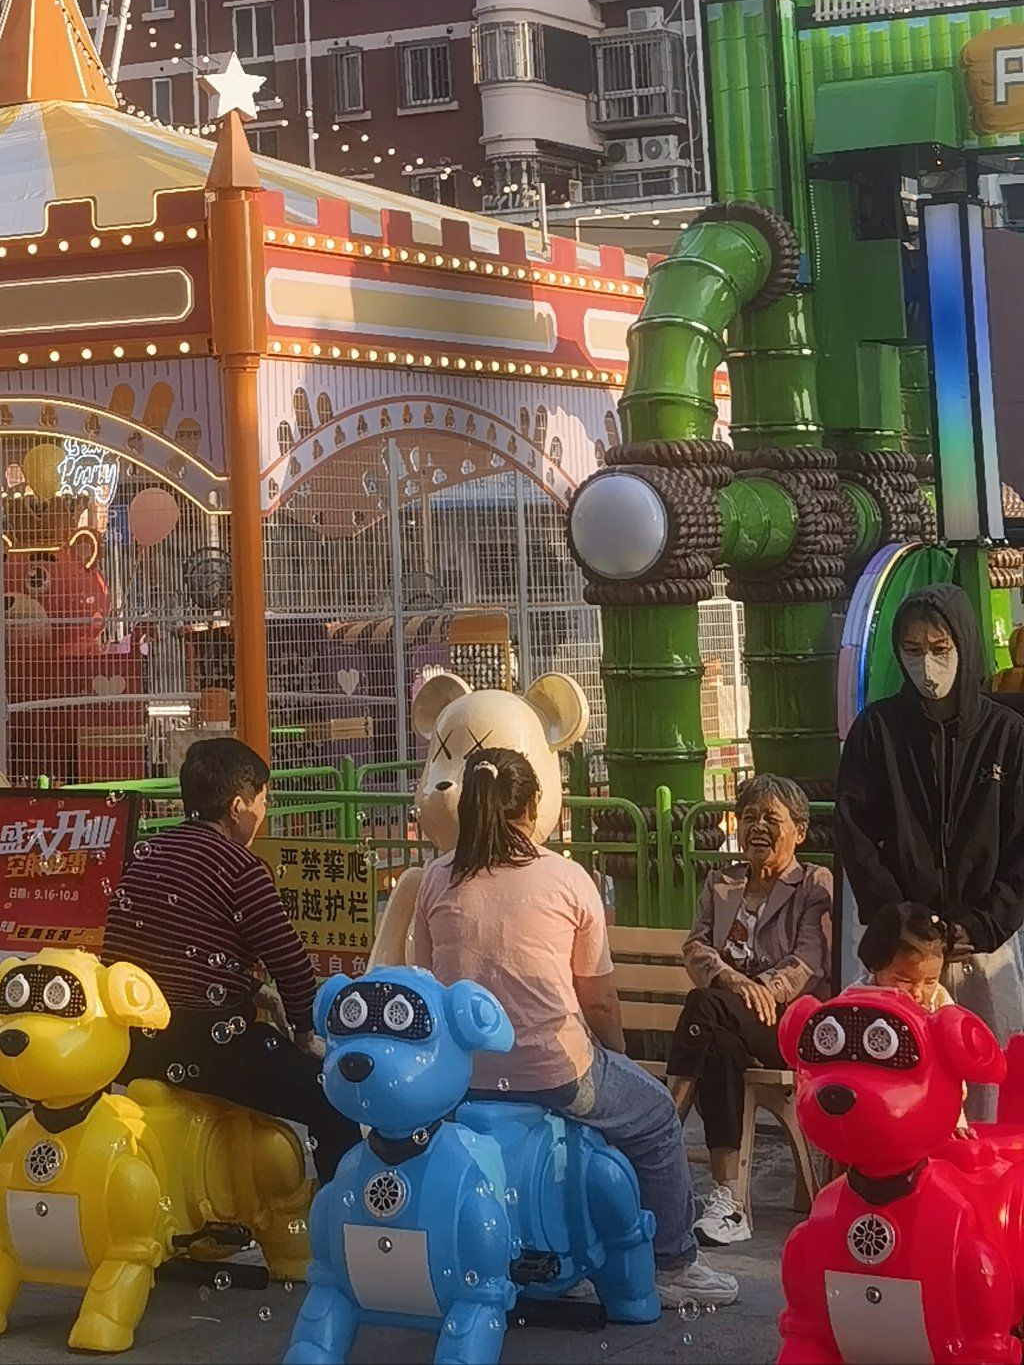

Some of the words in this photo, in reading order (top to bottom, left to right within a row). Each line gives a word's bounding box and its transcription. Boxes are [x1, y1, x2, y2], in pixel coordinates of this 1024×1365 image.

[278, 847, 368, 883] 严禁攀爬
[279, 887, 369, 924] 翻越护栏
